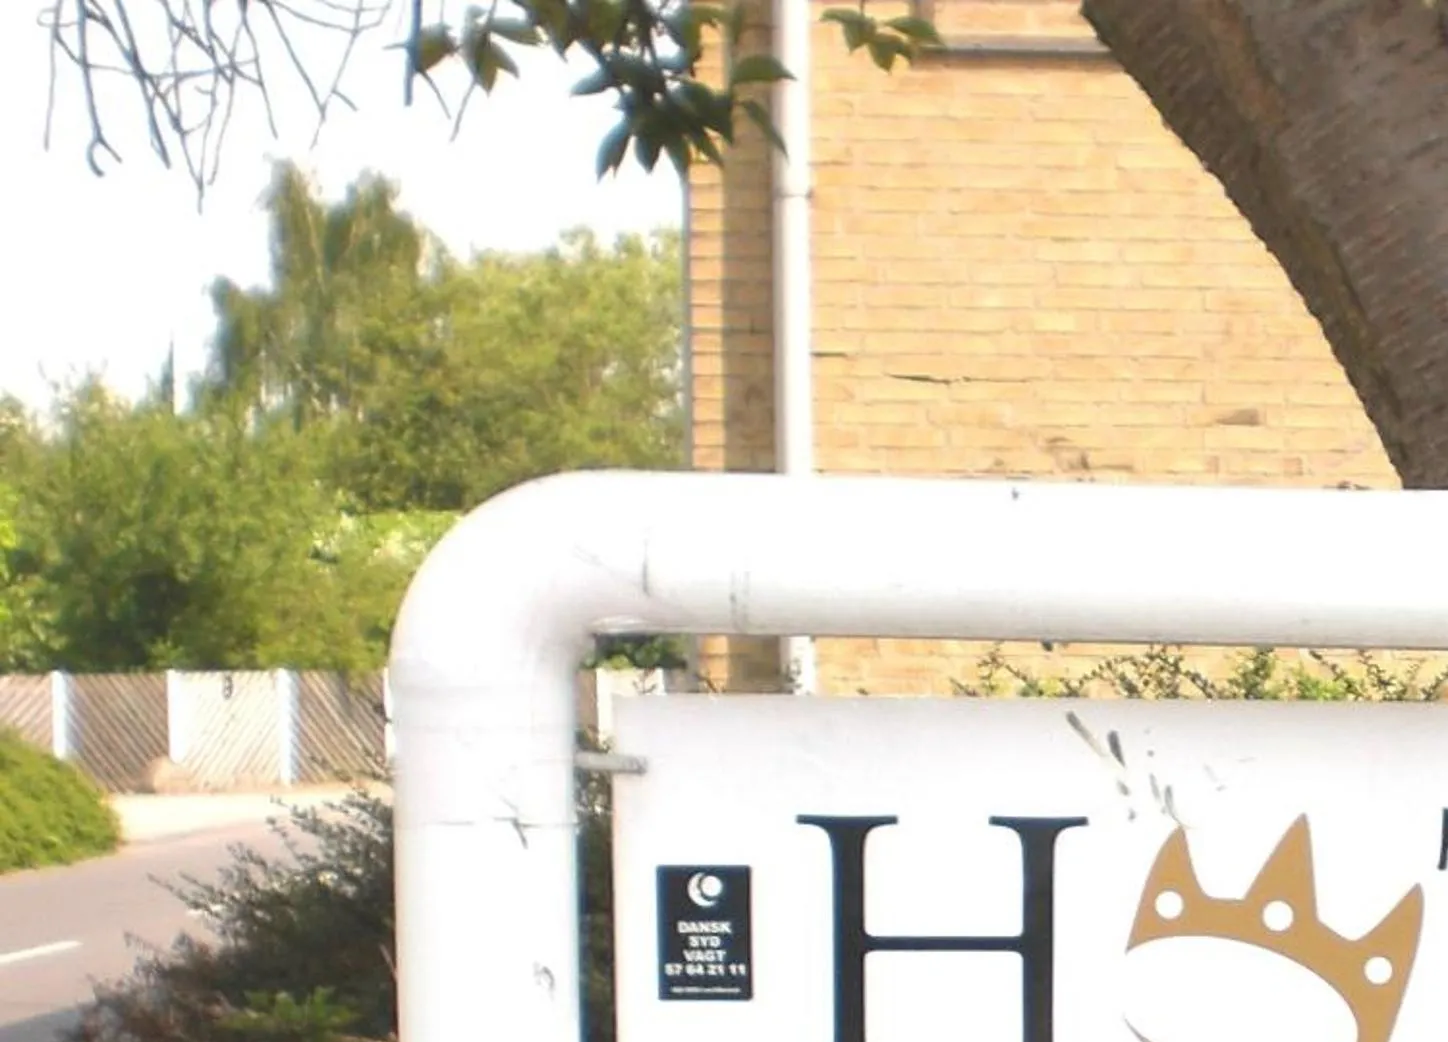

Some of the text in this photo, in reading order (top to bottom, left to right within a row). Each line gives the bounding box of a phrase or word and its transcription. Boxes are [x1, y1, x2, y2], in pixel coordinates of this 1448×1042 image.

[677, 920, 732, 933] DANSK
[688, 935, 722, 948] SYD
[683, 949, 727, 962] VAGT
[729, 962, 746, 976] 11
